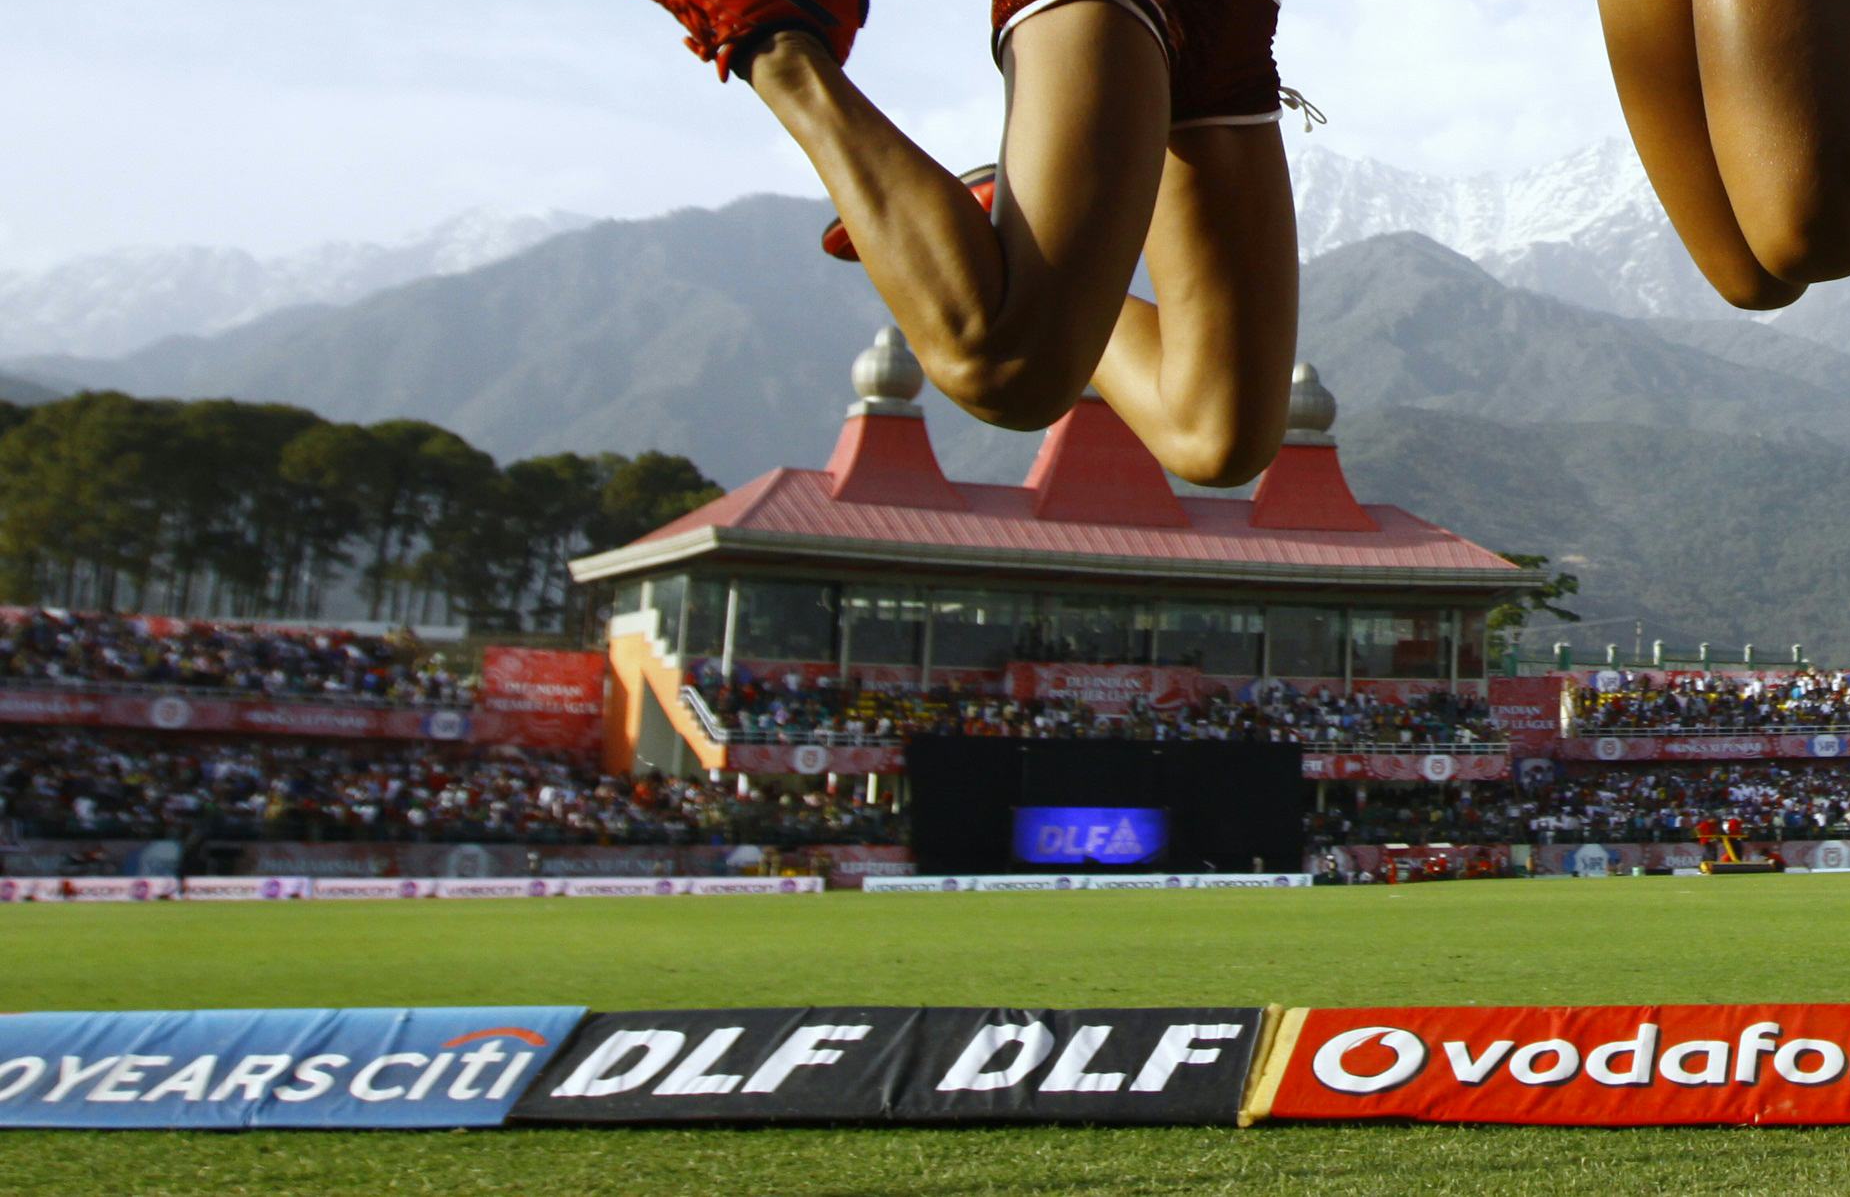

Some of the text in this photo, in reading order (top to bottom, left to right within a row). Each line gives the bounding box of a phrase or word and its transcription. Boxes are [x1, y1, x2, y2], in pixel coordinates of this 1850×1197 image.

[1036, 825, 1111, 855] DLF
[350, 1038, 535, 1102] citi
[550, 1020, 1244, 1097] DLF DLF
